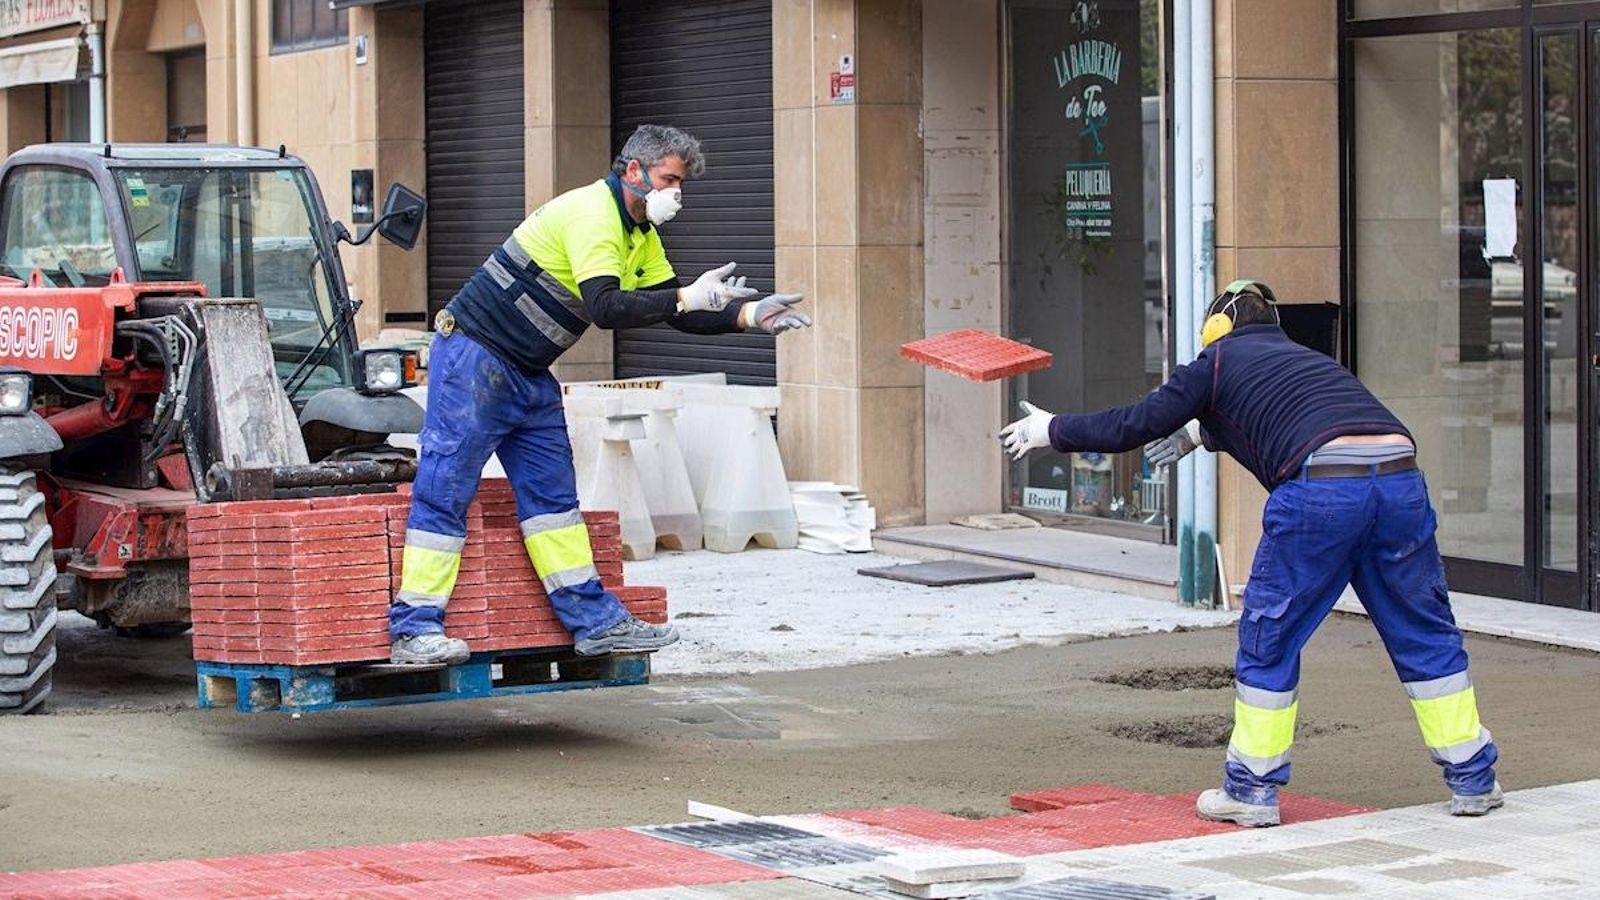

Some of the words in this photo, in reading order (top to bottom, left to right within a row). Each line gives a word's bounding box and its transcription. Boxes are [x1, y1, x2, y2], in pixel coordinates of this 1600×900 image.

[1054, 50, 1072, 88] LA
[1069, 40, 1121, 85] BARBERÍA
[1065, 96, 1081, 118] de
[1066, 167, 1111, 200] PELUQUERÍA
[0, 306, 79, 361] SCOPIC
[1028, 492, 1061, 508] Brott
